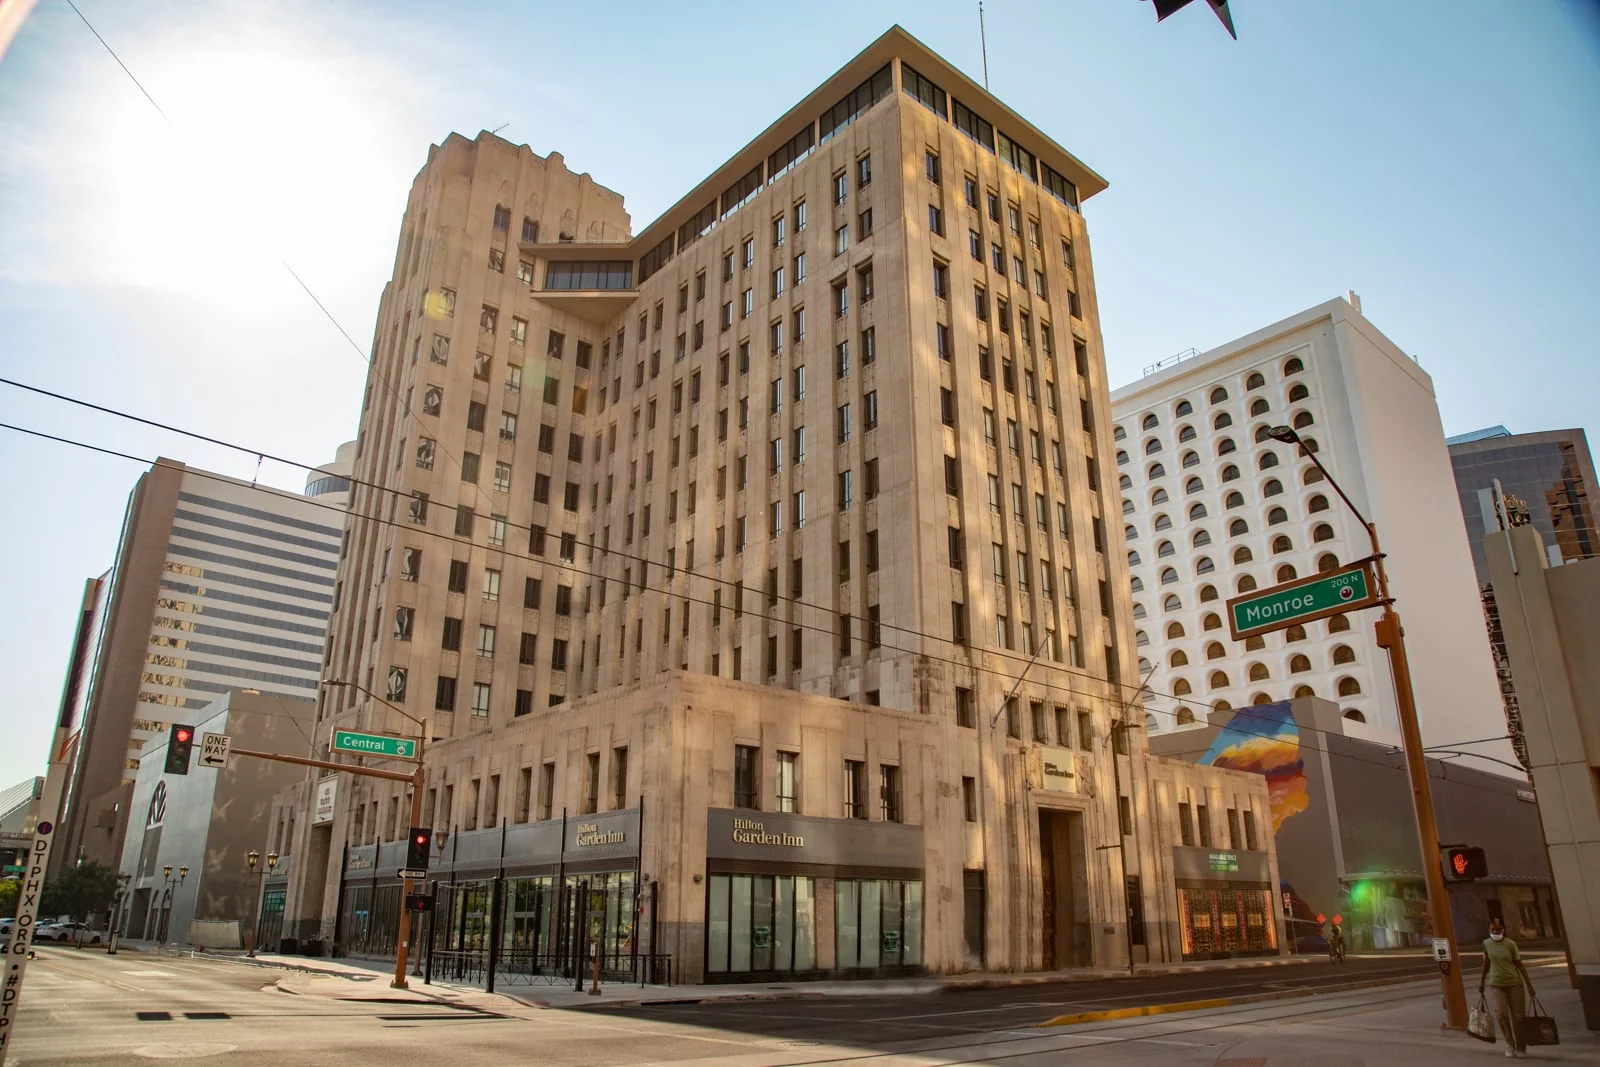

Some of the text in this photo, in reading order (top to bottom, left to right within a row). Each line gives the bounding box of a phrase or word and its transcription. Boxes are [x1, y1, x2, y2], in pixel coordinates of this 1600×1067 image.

[1331, 575, 1358, 588] 200 N
[1246, 594, 1314, 622] Monroe
[207, 735, 228, 746] ONE
[343, 736, 385, 751] Central
[205, 745, 228, 756] WAY
[734, 818, 764, 831] Hilton
[576, 829, 624, 847] Garden Inn
[733, 828, 804, 847] Garden Inn
